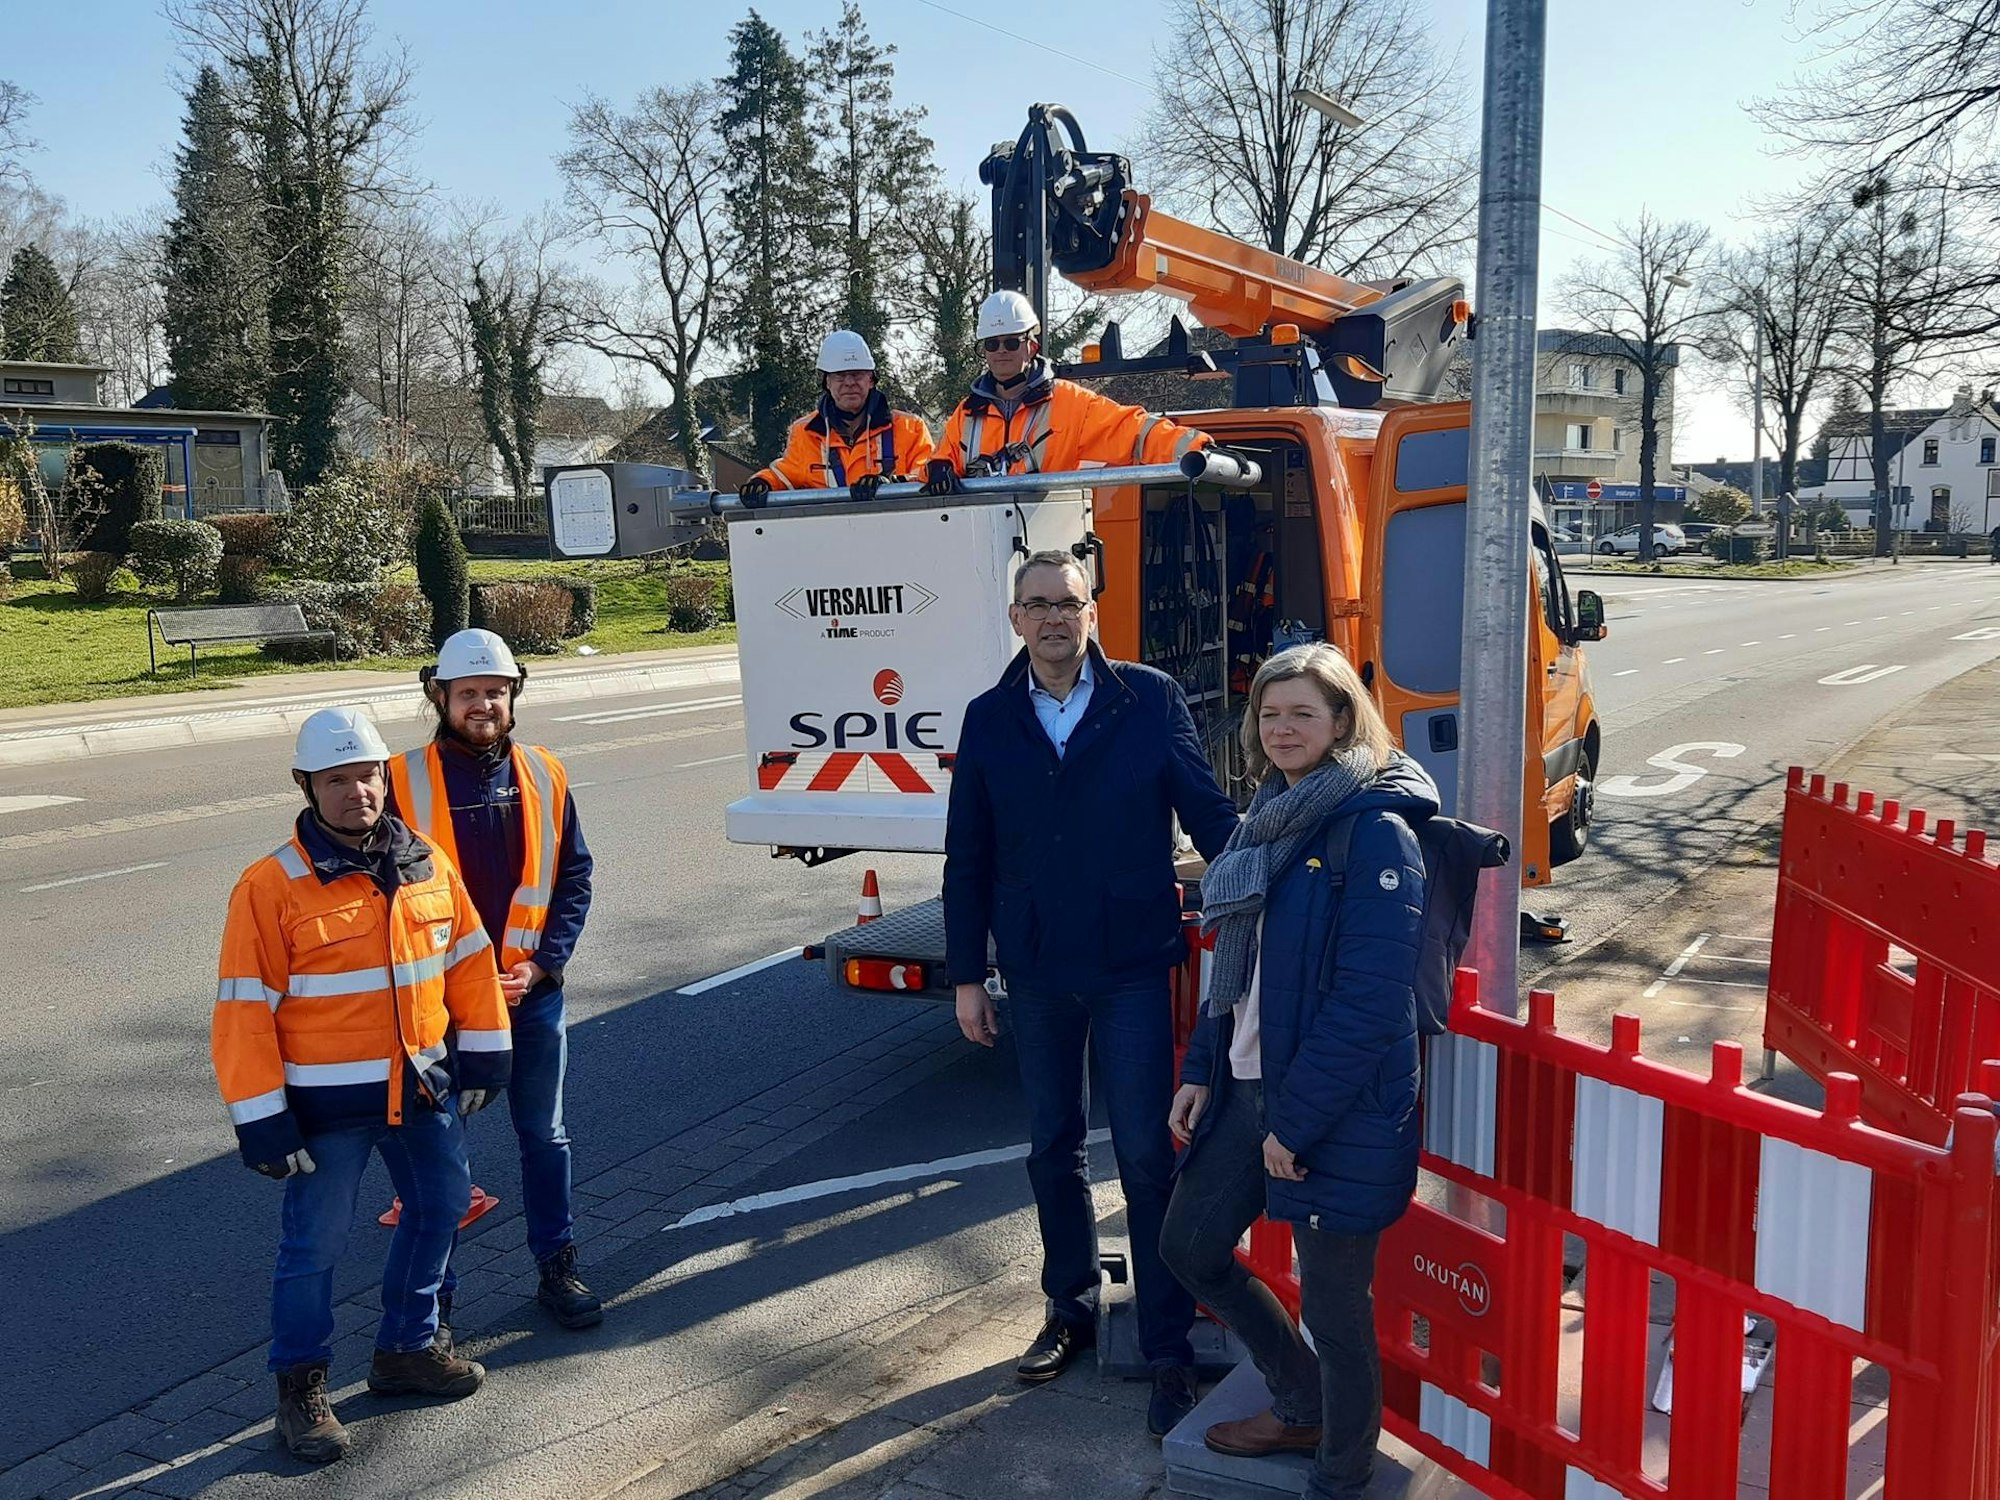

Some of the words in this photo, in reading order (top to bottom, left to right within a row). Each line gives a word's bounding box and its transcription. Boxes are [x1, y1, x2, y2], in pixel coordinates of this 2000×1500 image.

[806, 585, 903, 616] VERSALIFT
[860, 629, 895, 638] PRODUCT
[790, 712, 944, 749] SPIE
[496, 786, 520, 797] SP
[1414, 1255, 1484, 1303] OKUTAN
